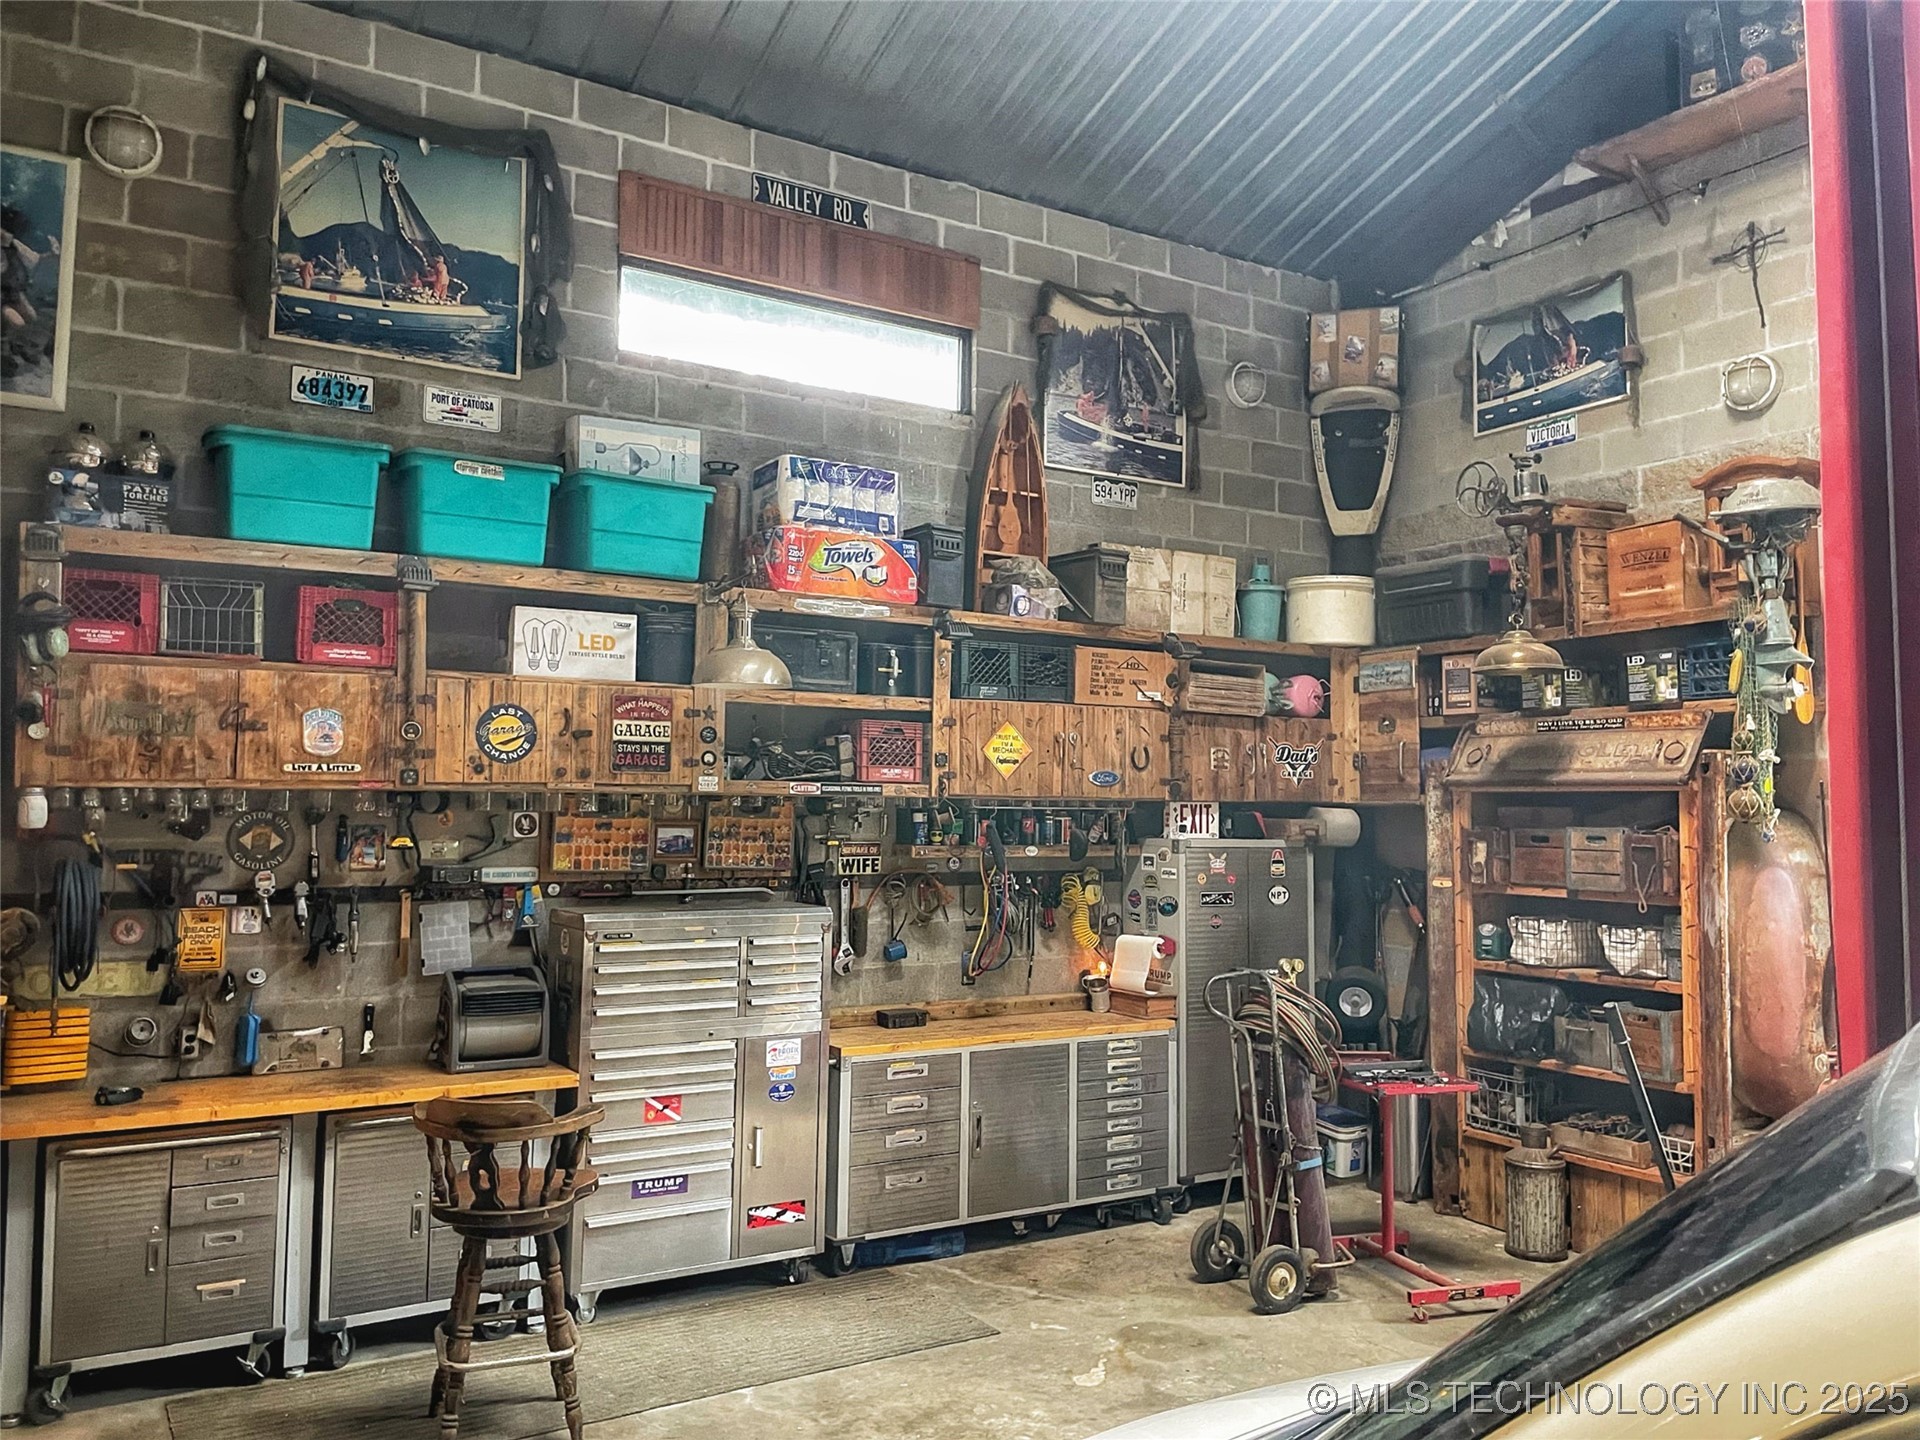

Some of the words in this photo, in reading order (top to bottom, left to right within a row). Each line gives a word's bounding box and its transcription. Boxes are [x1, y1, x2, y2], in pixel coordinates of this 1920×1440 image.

[766, 179, 822, 216] VALLEY
[833, 197, 857, 225] RD.
[316, 370, 351, 381] PANAMA
[296, 376, 369, 403] 684397
[431, 393, 450, 405] PORT
[451, 396, 462, 406] OF
[462, 398, 494, 412] CATOOSA
[1531, 422, 1571, 443] VICTORIA
[123, 484, 168, 496] PATIO
[123, 491, 168, 503] TORCHES
[823, 547, 875, 567] Towels
[1620, 549, 1670, 565] WENZEL
[578, 631, 618, 652] LED
[1125, 661, 1140, 670] HD
[1626, 656, 1646, 667] LED
[1564, 669, 1583, 682] LED
[491, 707, 524, 718] LAST
[615, 700, 637, 714] WHAT
[638, 697, 670, 717] HAPPENS
[480, 720, 534, 743] Garage
[614, 723, 670, 738] GARAGE
[484, 741, 531, 760] CHANCE
[617, 744, 641, 754] STAYS
[641, 745, 650, 753] IN
[651, 745, 666, 754] THE
[992, 746, 1023, 754] MECHANIC
[1275, 745, 1318, 763] Dad's
[316, 762, 325, 772] A
[615, 753, 667, 767] GARAGE
[1096, 773, 1113, 783] Ford
[1281, 770, 1312, 778] GARAGE
[235, 811, 273, 829] MOTOR
[275, 817, 290, 831] OIL
[1180, 803, 1212, 834] EXIT
[234, 852, 283, 870] GASOLINE
[841, 857, 880, 874] WIFE
[1270, 891, 1287, 900] NPT
[184, 926, 221, 934] BEACH
[1149, 969, 1172, 981] RUMP
[637, 1176, 684, 1190] TRUMP
